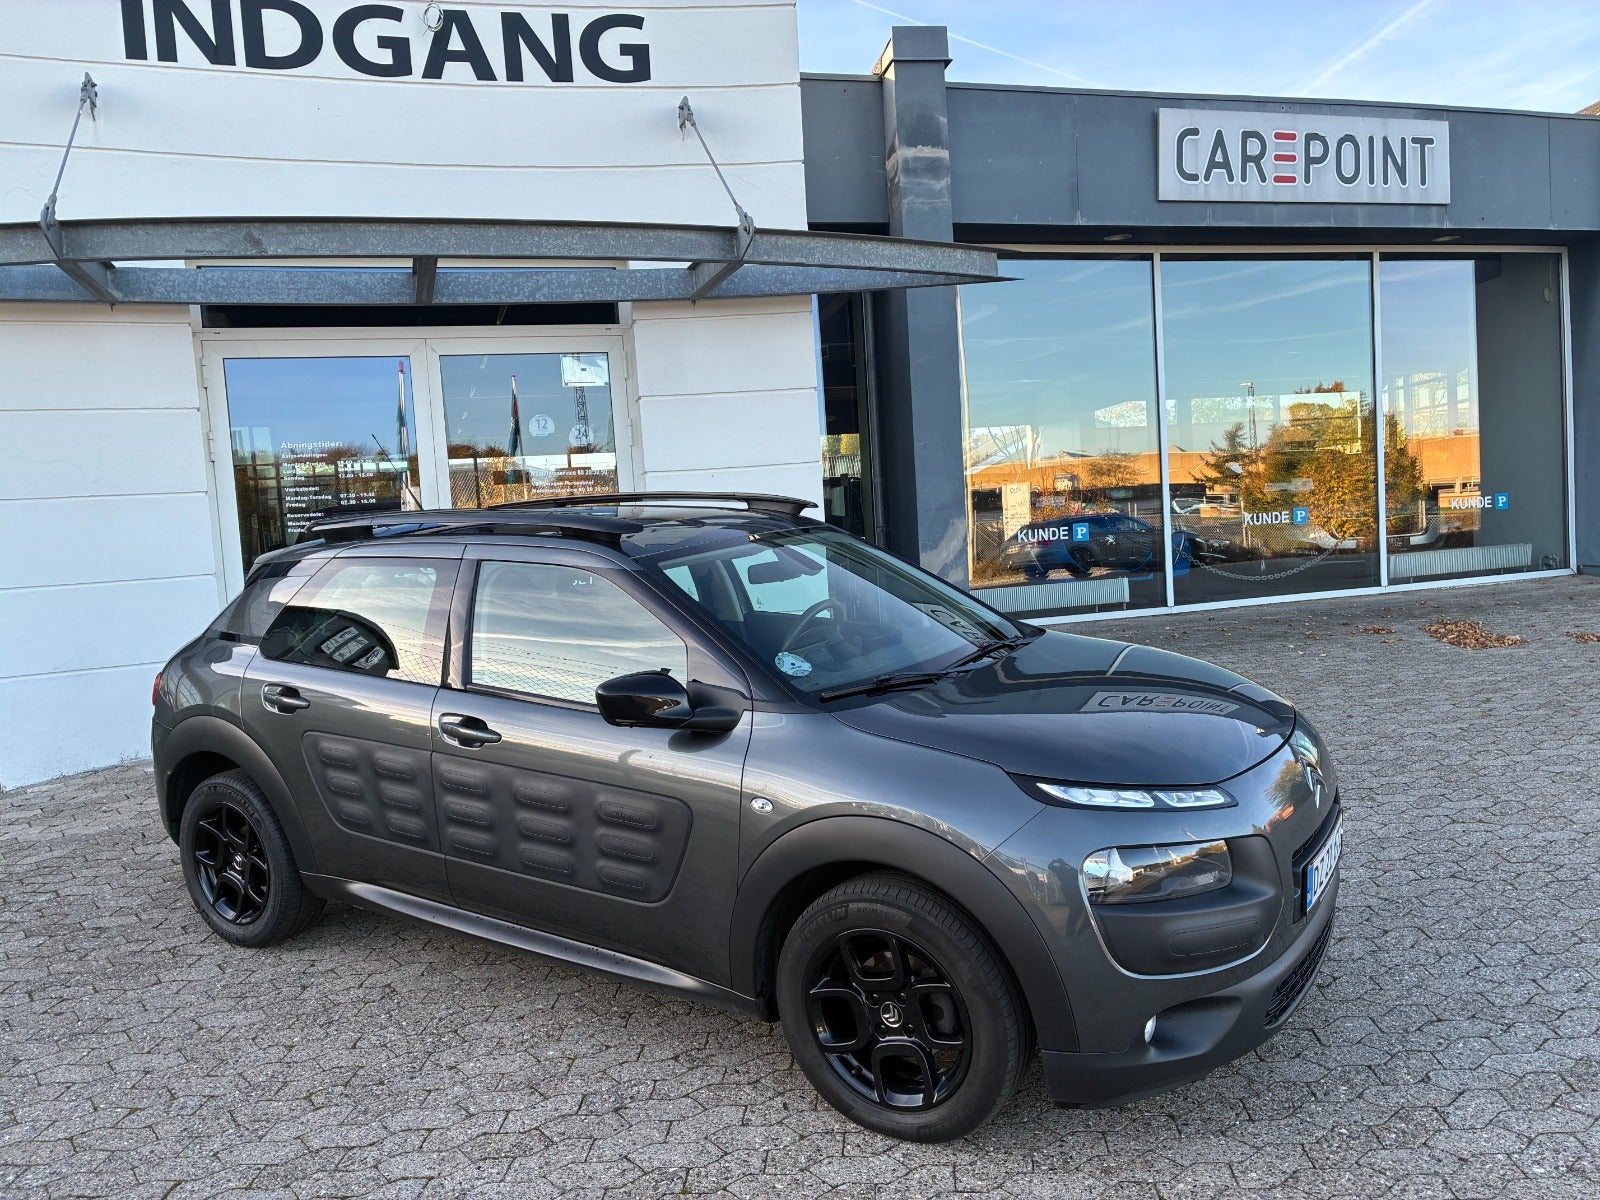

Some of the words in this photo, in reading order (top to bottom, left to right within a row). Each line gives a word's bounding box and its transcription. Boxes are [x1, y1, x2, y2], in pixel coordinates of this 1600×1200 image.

[120, 0, 652, 84] INDGANG
[1175, 127, 1436, 189] CAREPOINT
[1450, 496, 1493, 510] KUNDE
[1243, 511, 1291, 528] KUNDE
[1016, 526, 1069, 544] KUNDE
